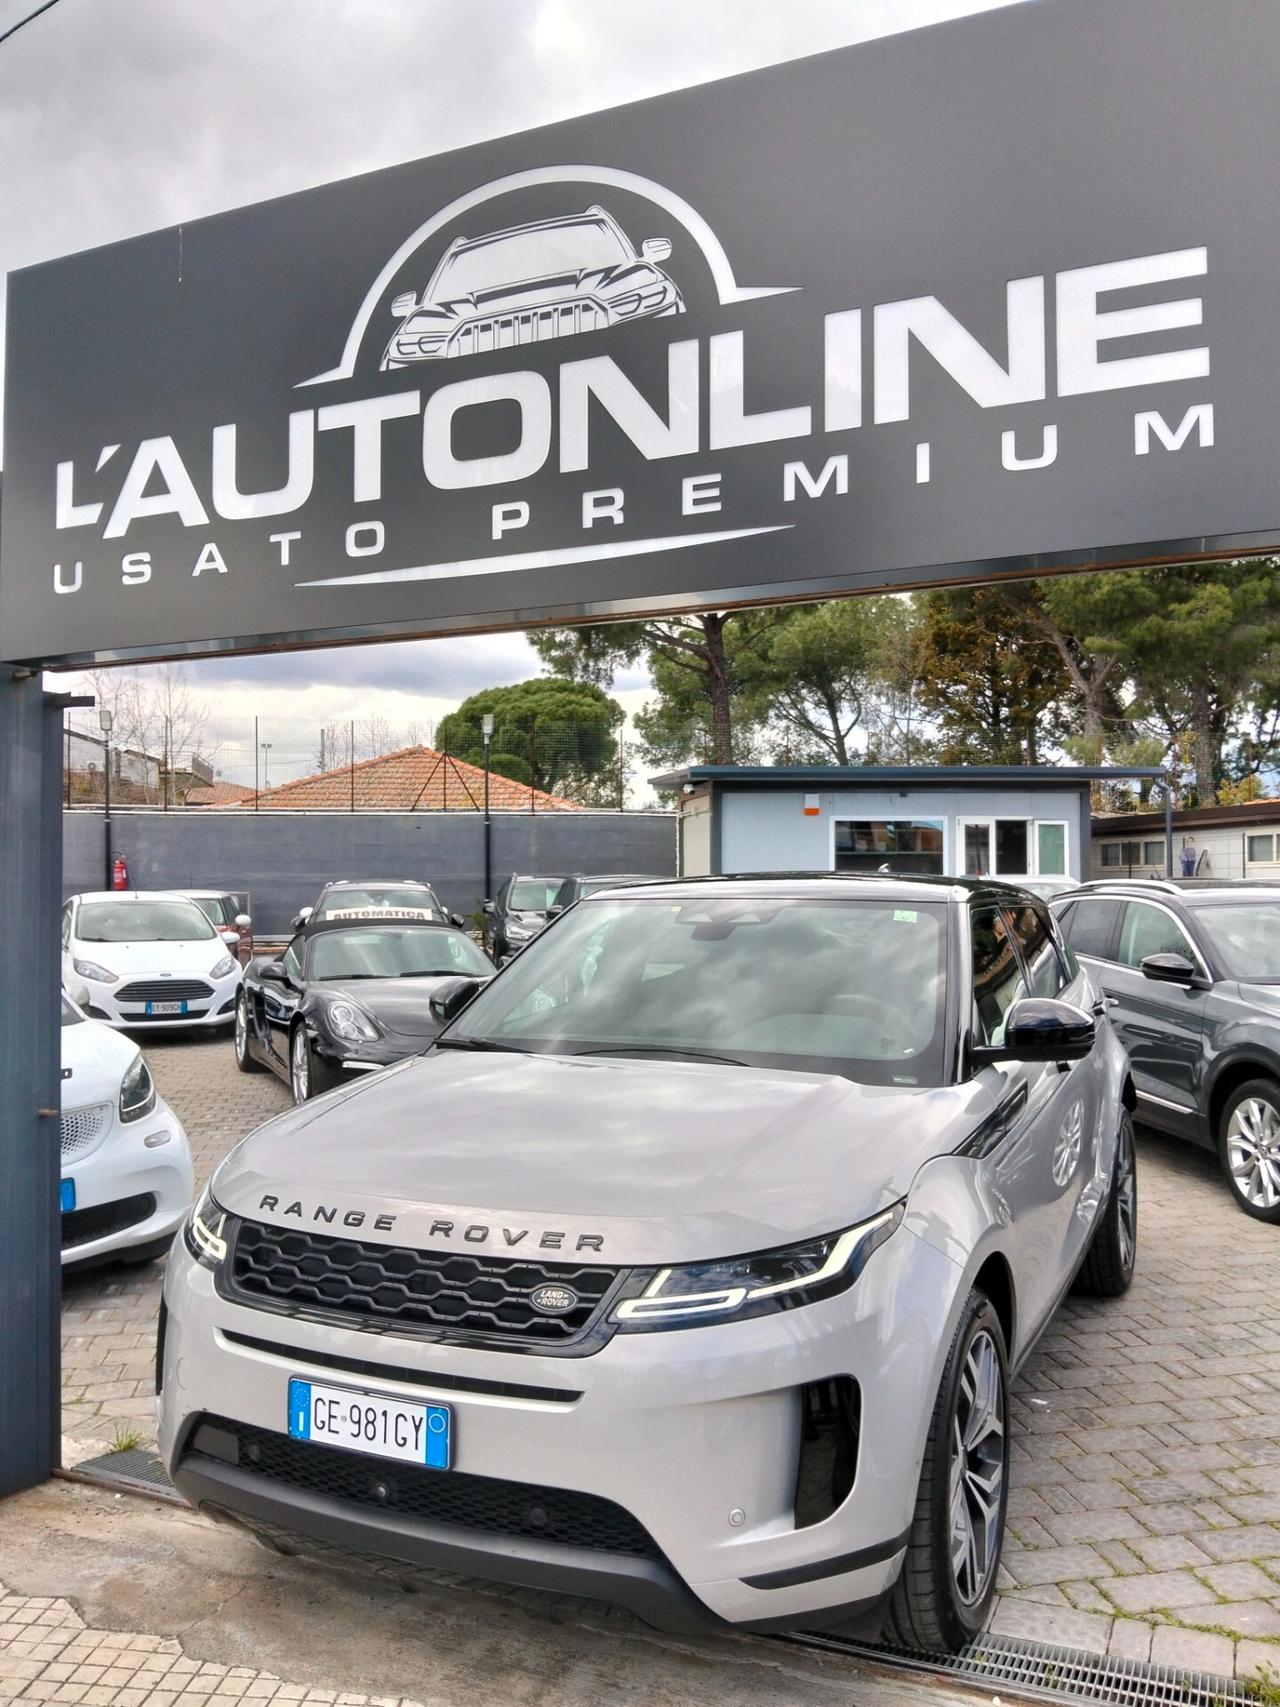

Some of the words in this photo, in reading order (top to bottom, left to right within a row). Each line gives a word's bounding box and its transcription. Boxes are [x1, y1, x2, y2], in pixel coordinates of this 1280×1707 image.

[53, 520, 386, 595] USATO
[491, 403, 1215, 541] PREMIUM
[333, 910, 426, 920] AUTOMATICA
[259, 1194, 397, 1232] RANGE
[429, 1219, 605, 1253] ROVER
